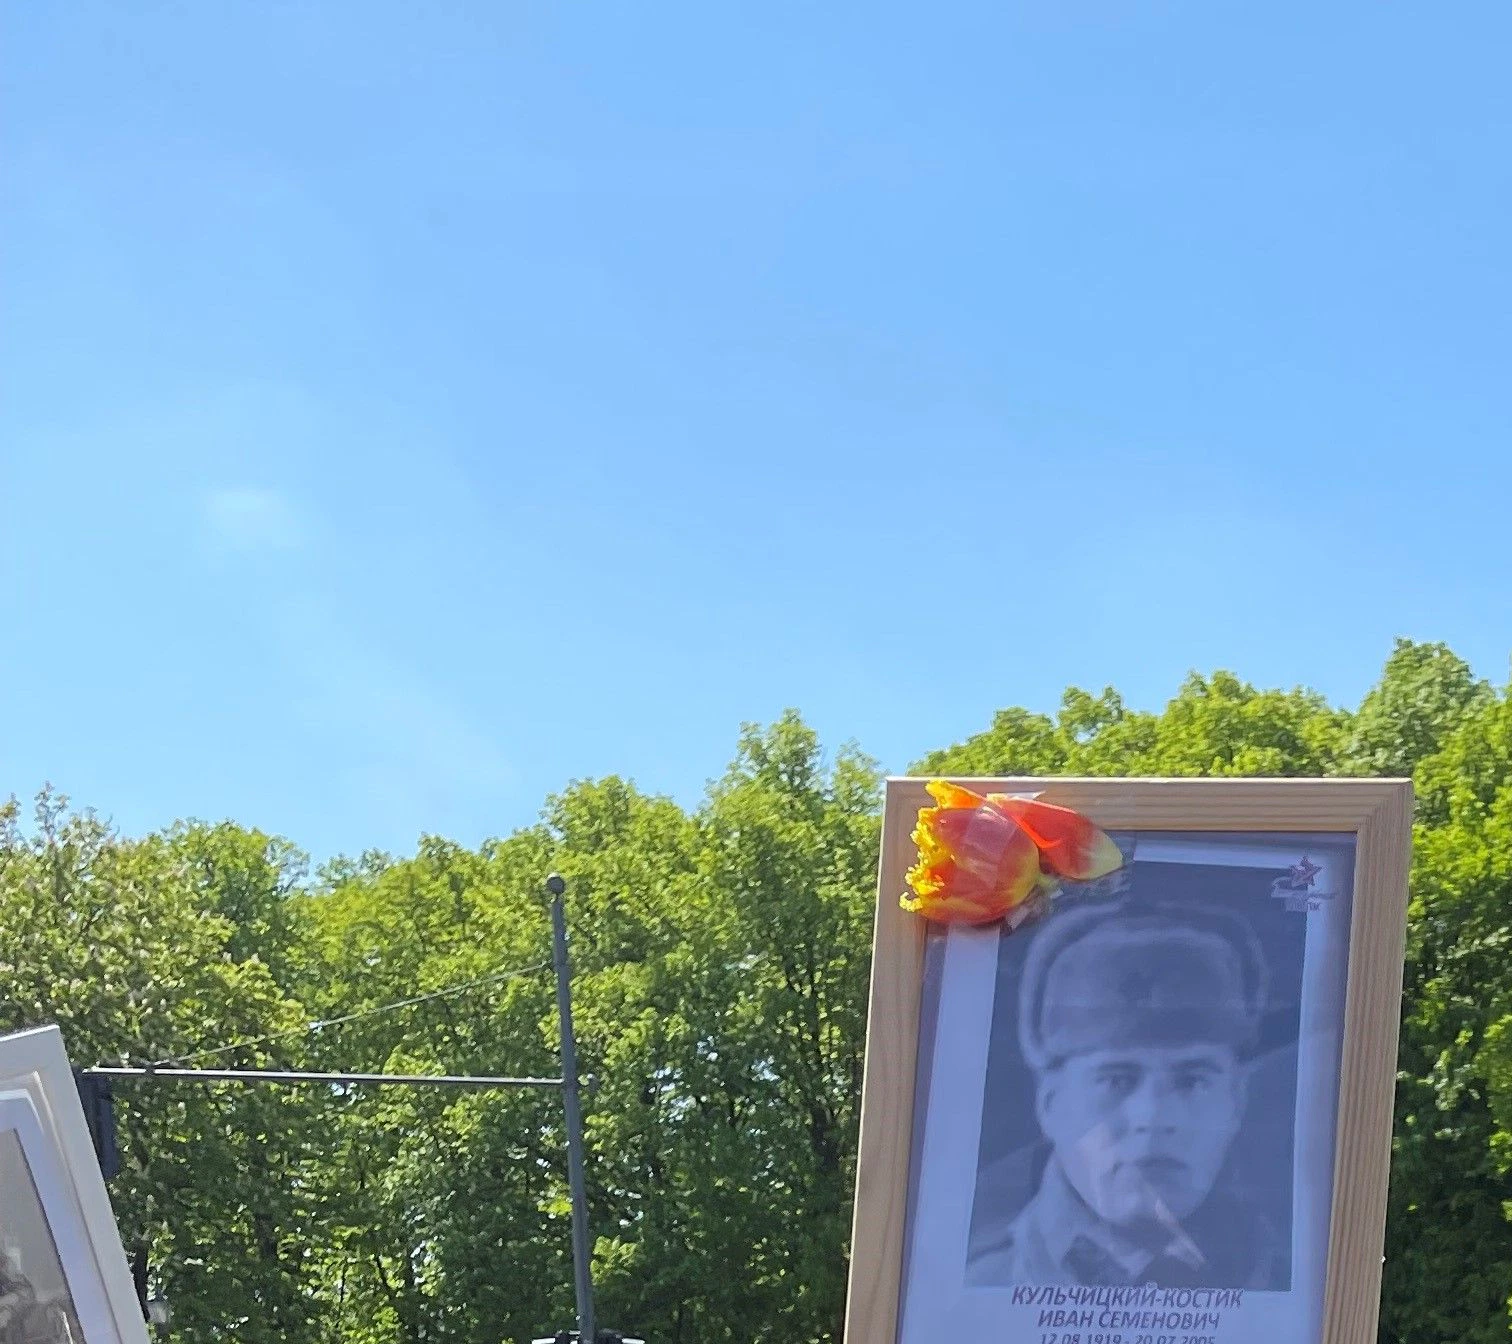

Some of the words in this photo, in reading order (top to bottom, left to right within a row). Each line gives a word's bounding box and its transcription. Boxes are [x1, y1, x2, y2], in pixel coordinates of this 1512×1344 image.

[1011, 1283, 1244, 1310] КУЛЬЧИЦКИЙ-КОСТИК
[1038, 1310, 1095, 1328] ИВАН
[1098, 1311, 1221, 1330] СЕМЕНОВИЧ
